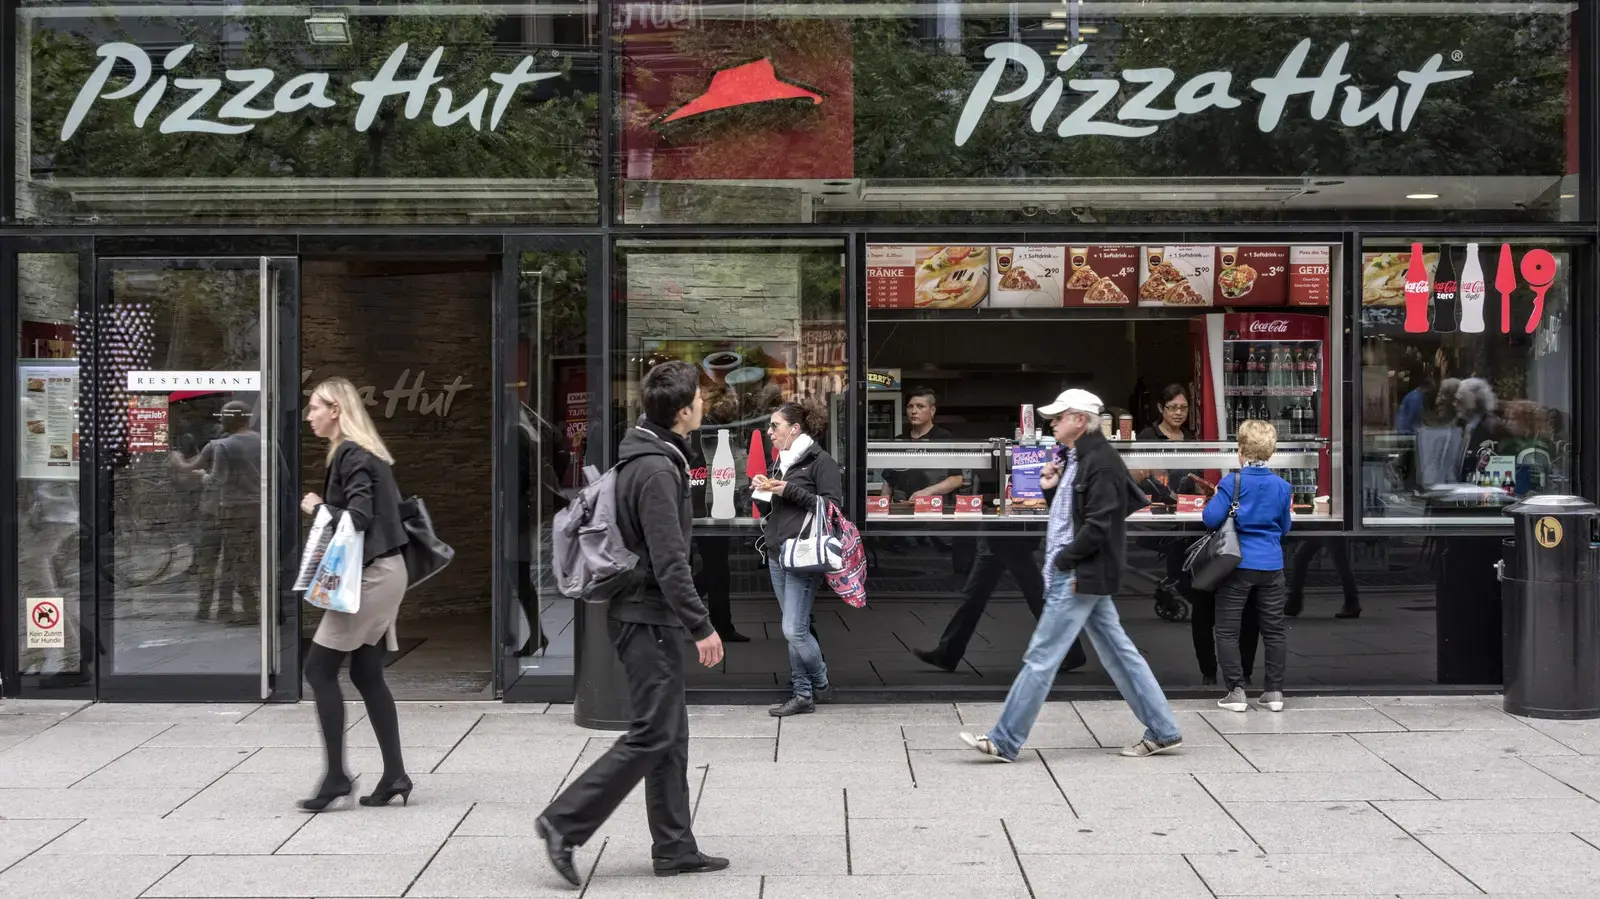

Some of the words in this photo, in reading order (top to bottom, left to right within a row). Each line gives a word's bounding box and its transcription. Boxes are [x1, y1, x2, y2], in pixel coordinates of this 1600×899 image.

[60, 42, 336, 142] Pizza
[352, 42, 562, 132] Hut
[954, 42, 1241, 147] Pizza
[1251, 37, 1474, 132] Hut
[1250, 319, 1290, 333] Coca-Cola
[137, 377, 253, 385] RESTAURANT
[383, 368, 474, 419] Hut
[867, 373, 892, 386] ERRY'S
